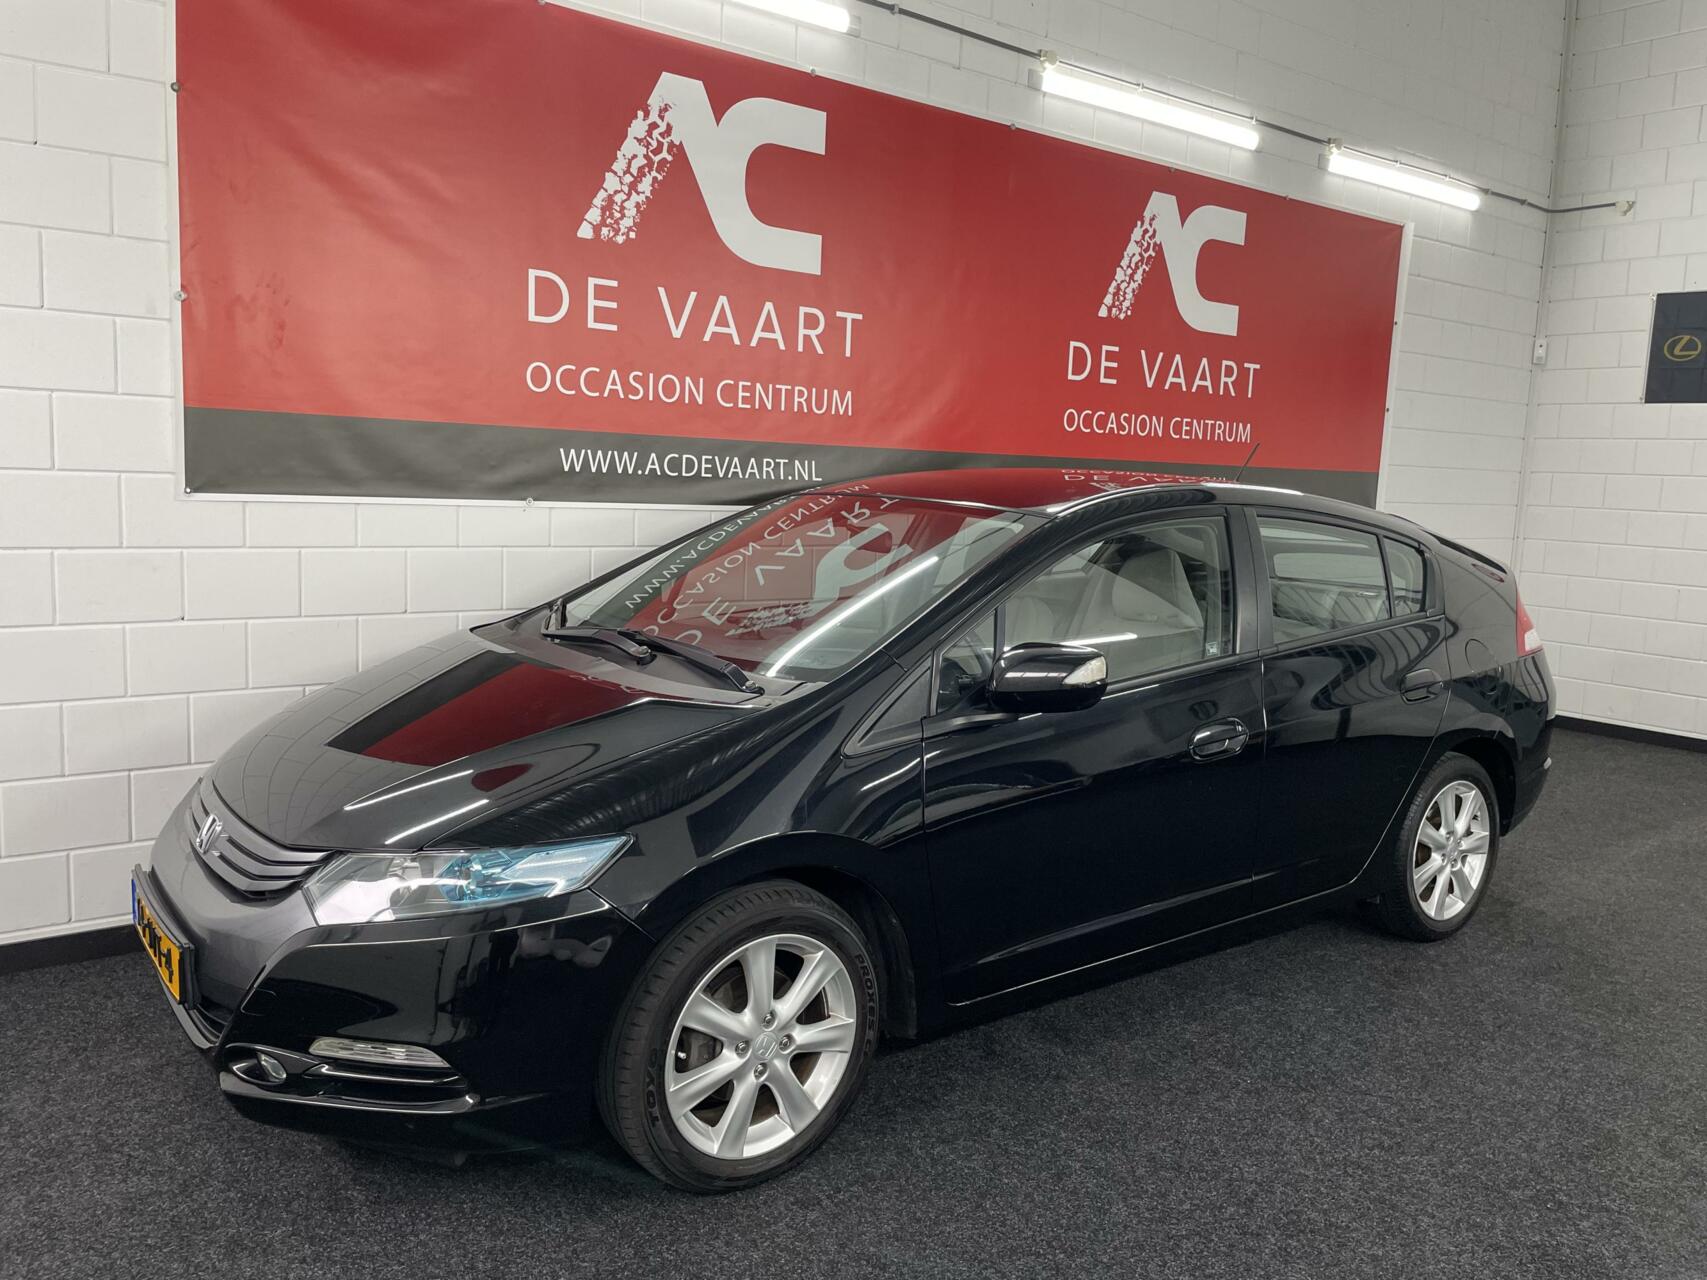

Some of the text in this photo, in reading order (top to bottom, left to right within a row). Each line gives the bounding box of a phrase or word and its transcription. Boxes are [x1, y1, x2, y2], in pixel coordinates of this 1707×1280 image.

[577, 71, 827, 276] AC
[1098, 191, 1248, 337] AC
[527, 268, 863, 358] DE VAART
[526, 361, 853, 417] OCCASION CENTRUM
[1067, 340, 1261, 398] DE VAART
[1063, 408, 1251, 443] OCCASION CENTRUM
[559, 447, 823, 482] WWW.ACDEVAART.NL
